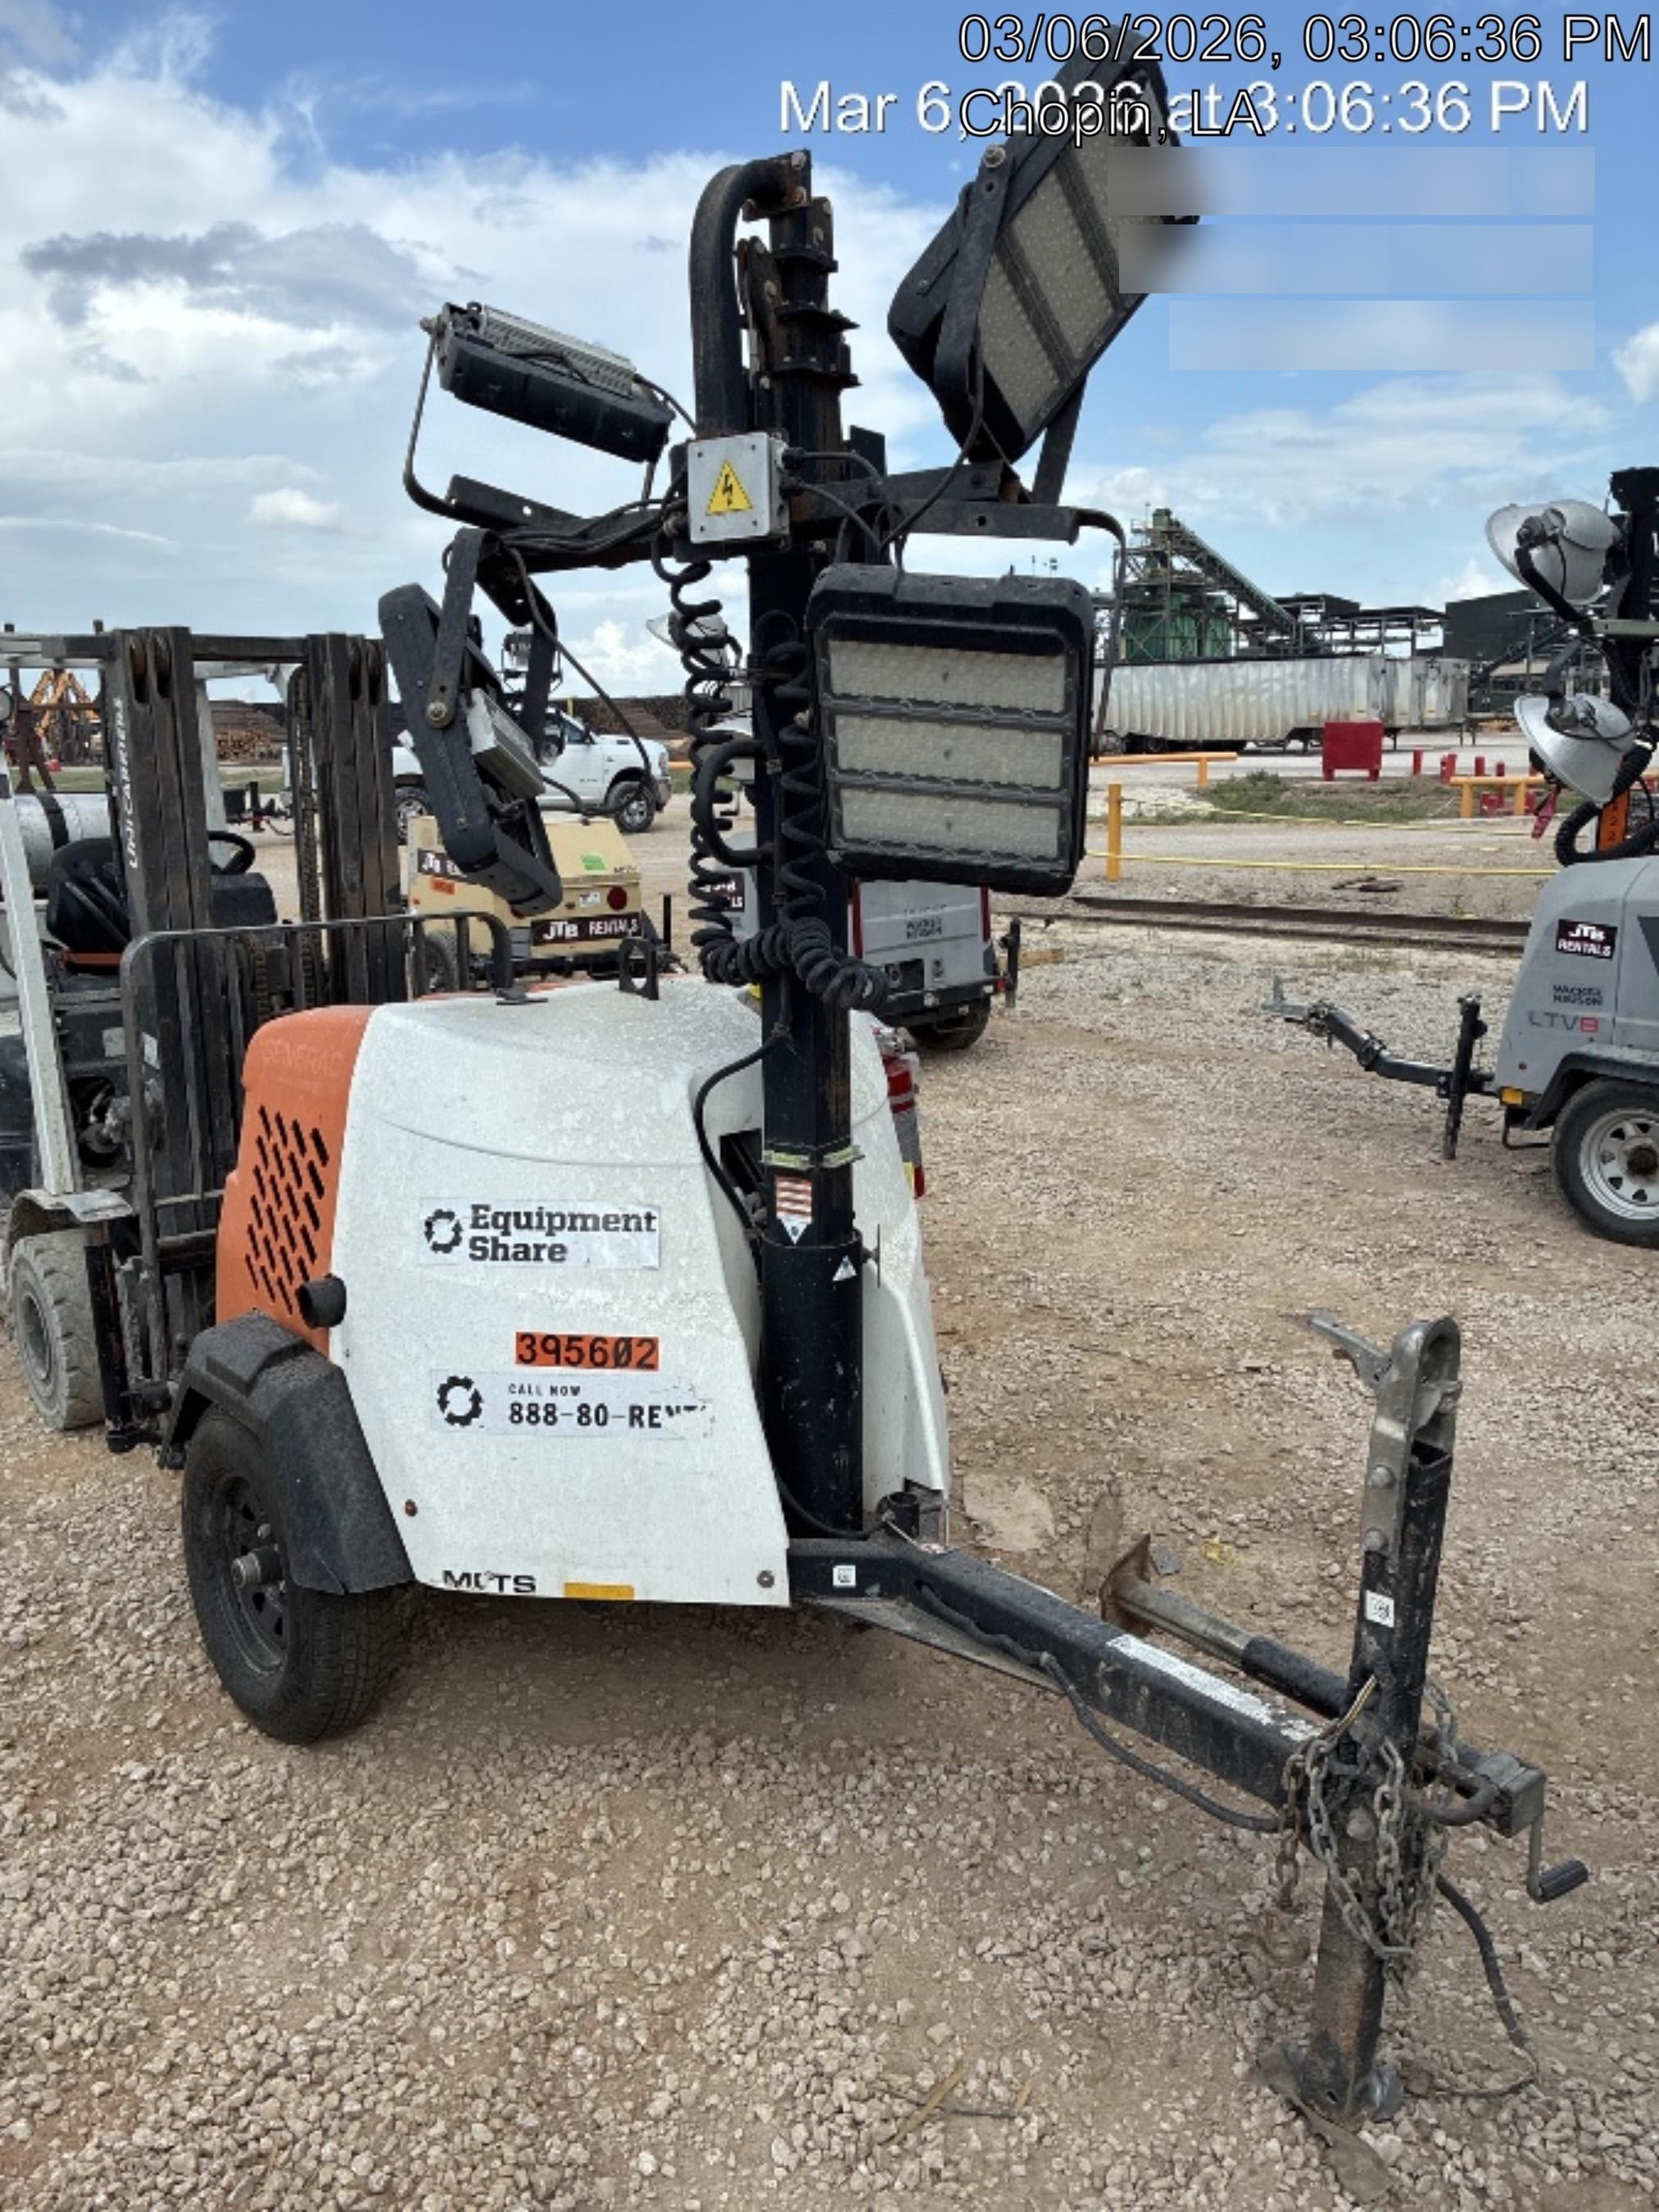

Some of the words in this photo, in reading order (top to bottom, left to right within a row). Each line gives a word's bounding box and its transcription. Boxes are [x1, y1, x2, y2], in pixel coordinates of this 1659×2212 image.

[542, 921, 578, 940] JTB
[588, 918, 639, 936] RENTALS
[1568, 924, 1606, 941] JTB
[1557, 938, 1611, 957] RENTALS
[469, 1203, 656, 1236] Equipment
[469, 1235, 568, 1262] Share
[518, 1333, 657, 1369] 395602
[508, 1384, 544, 1397] CALL
[550, 1385, 581, 1398] NOW
